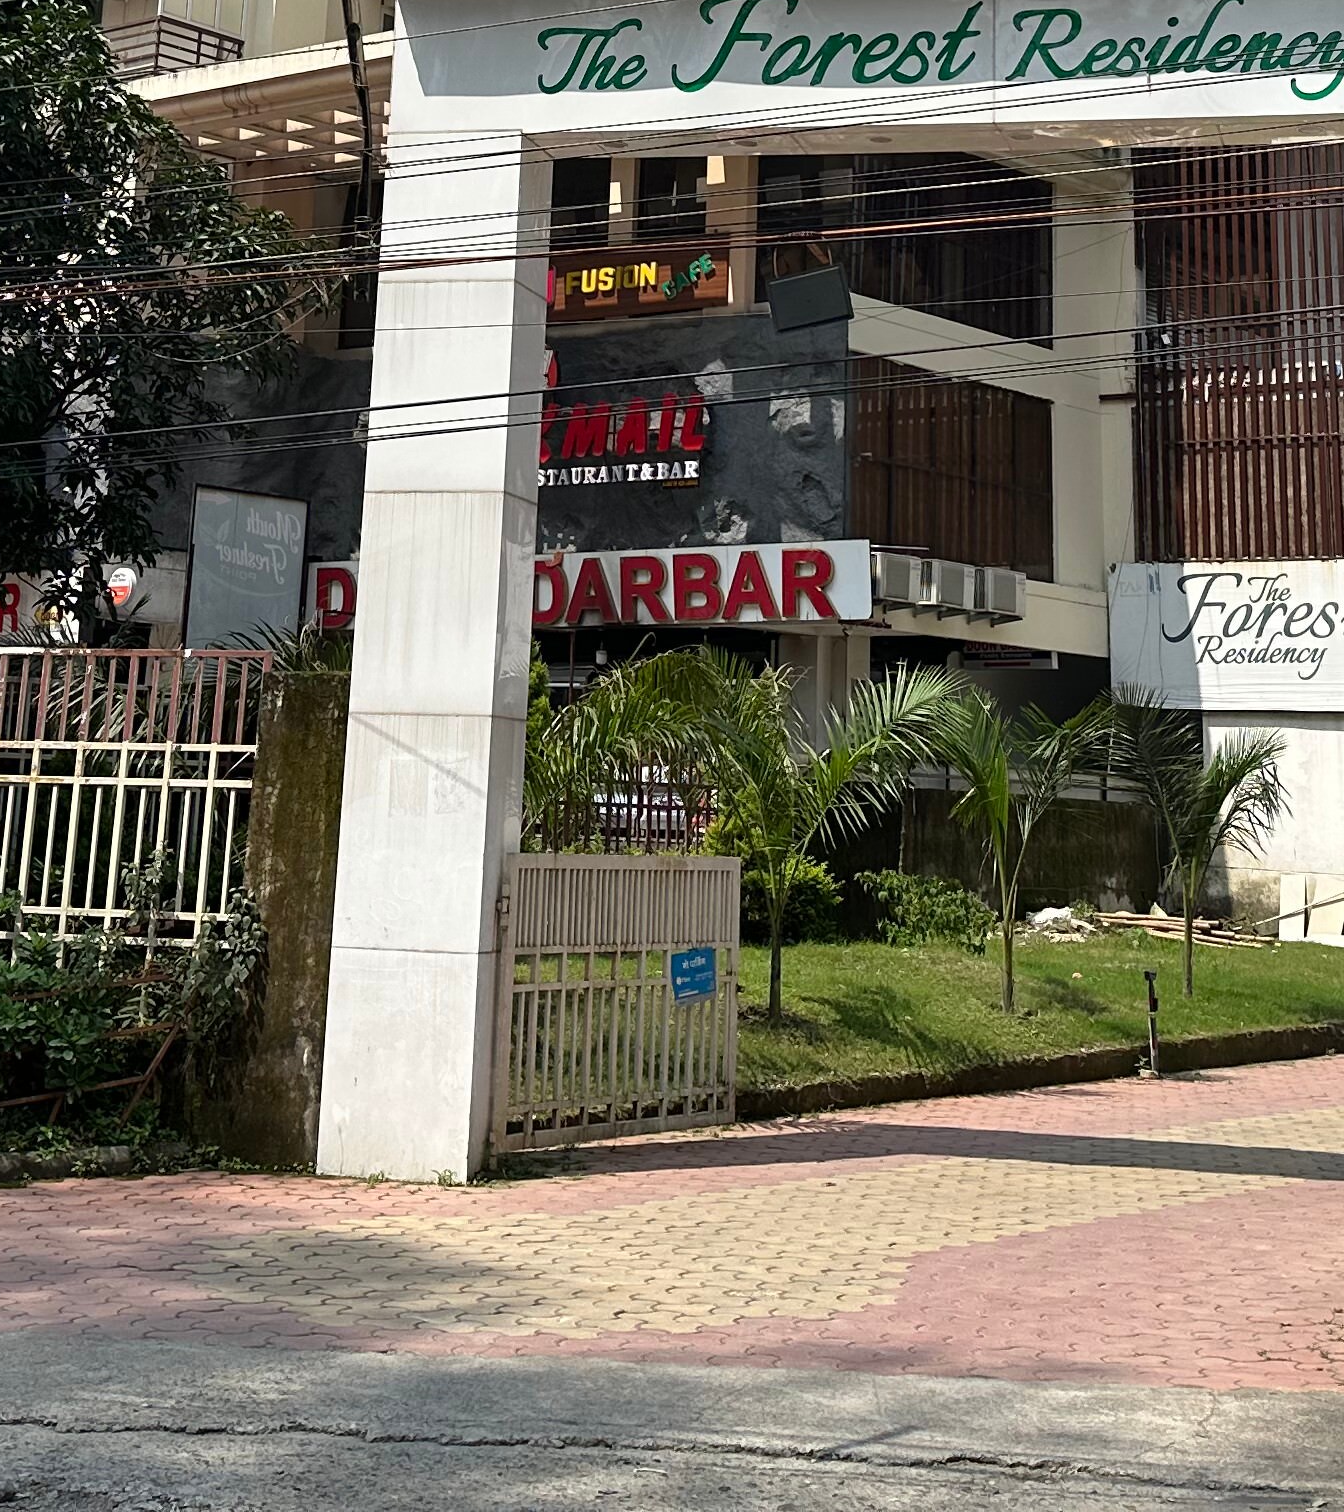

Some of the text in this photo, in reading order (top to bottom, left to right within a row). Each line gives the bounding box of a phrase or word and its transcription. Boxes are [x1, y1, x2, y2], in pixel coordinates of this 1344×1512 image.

[537, 18, 647, 95] The
[565, 261, 658, 296] FUSION
[661, 251, 716, 300] CAFE
[1247, 572, 1292, 603] The
[1195, 632, 1329, 680] Residency
